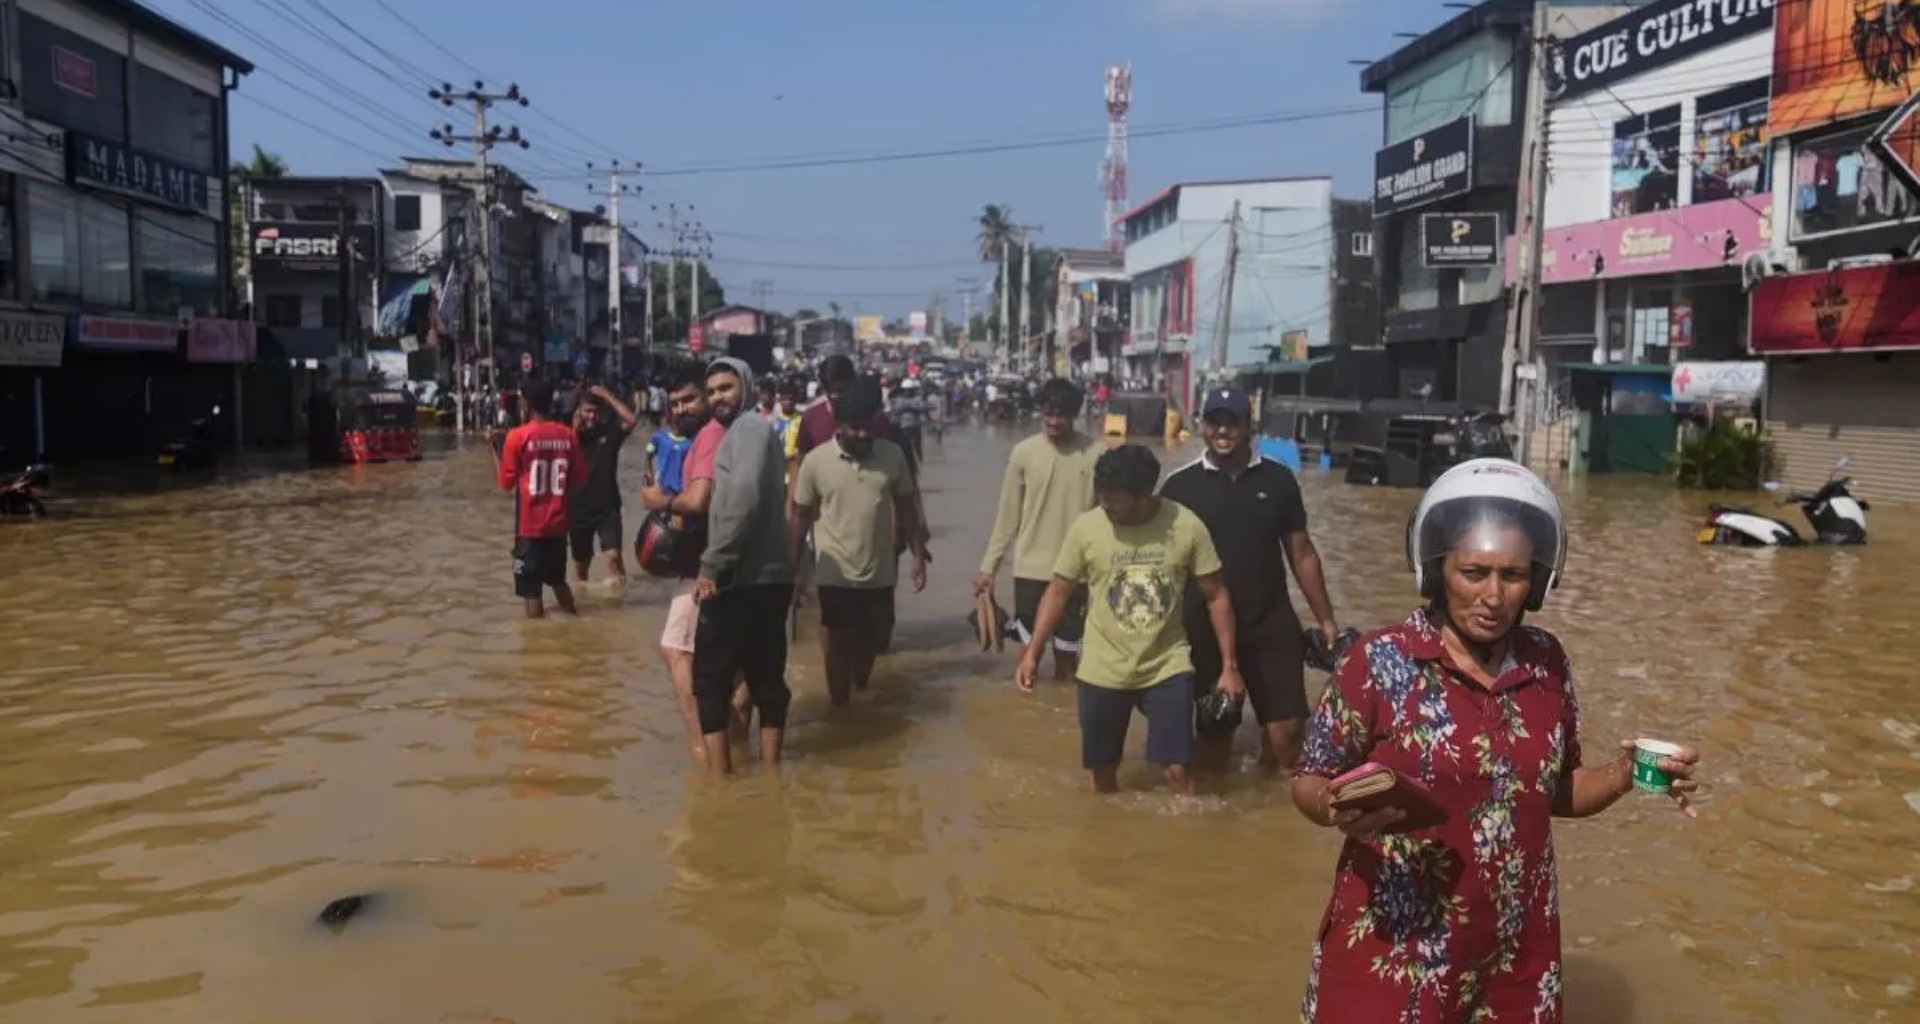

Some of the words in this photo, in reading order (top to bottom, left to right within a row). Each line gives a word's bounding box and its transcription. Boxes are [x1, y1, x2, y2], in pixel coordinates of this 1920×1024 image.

[1573, 28, 1630, 81] CUE
[88, 139, 202, 206] MADAME
[14, 319, 61, 347] QUEEN
[528, 457, 569, 497] 06
